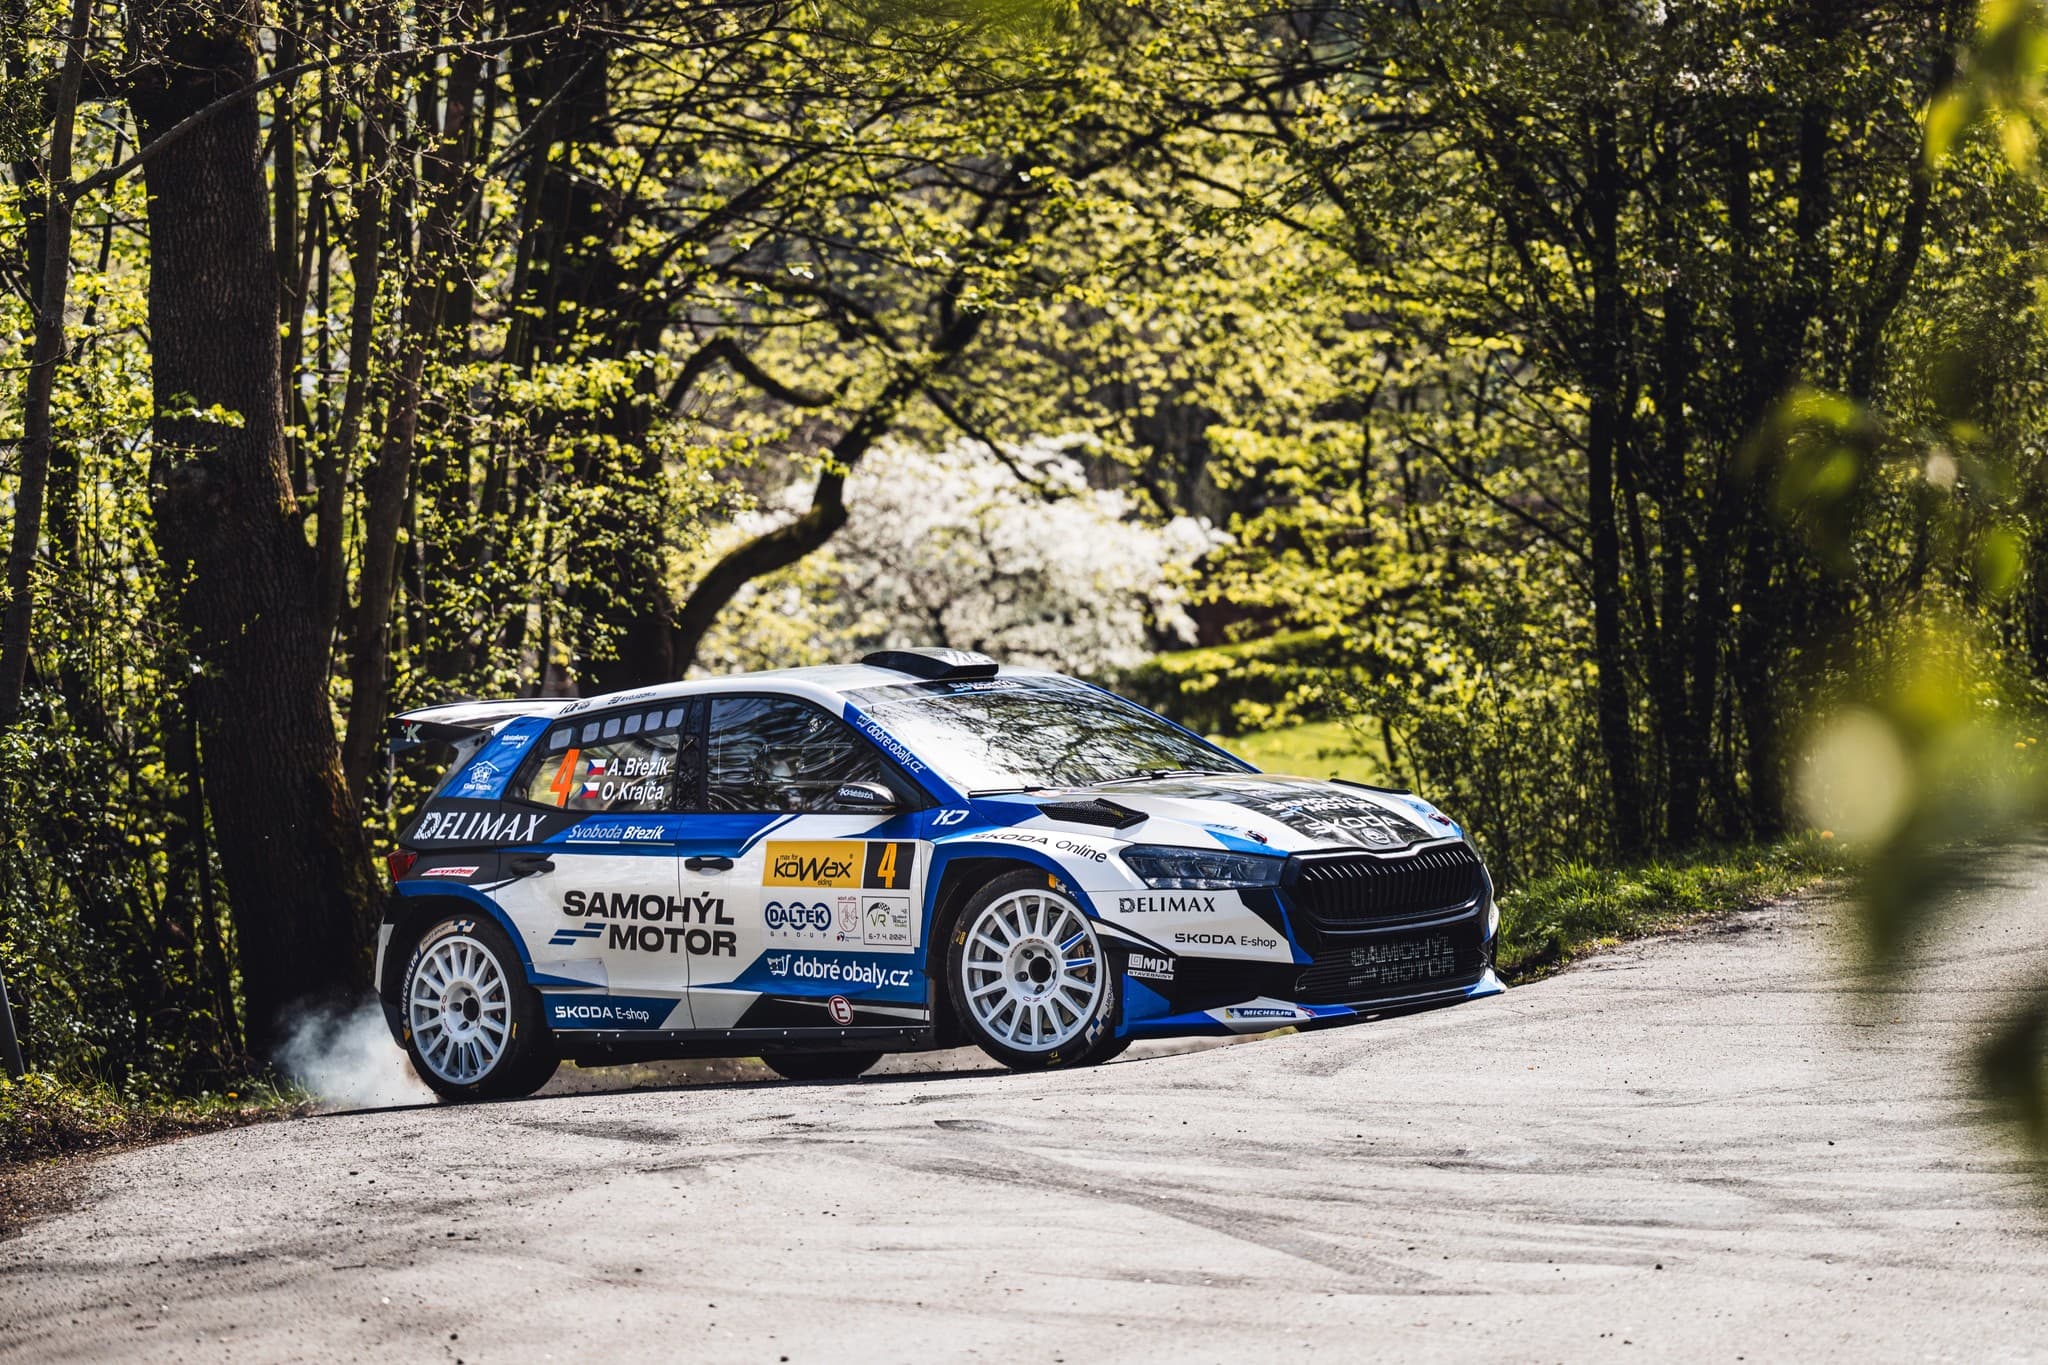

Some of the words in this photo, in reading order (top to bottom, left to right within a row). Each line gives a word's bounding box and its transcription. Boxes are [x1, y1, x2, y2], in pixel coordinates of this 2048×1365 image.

[551, 748, 580, 808] 4
[607, 758, 621, 776] A.
[624, 757, 670, 776] Březík
[602, 783, 616, 800] O.
[618, 781, 665, 805] Krajča
[414, 812, 547, 841] DELIMAX
[568, 824, 622, 839] Svoboda
[623, 825, 665, 840] Březík
[1055, 840, 1107, 863] Online
[877, 843, 897, 888] 4
[562, 890, 734, 925] SAMOHÝL
[769, 909, 826, 924] DALTEK
[1119, 897, 1216, 913] DELIMAX
[608, 924, 737, 957] MOTOR
[1240, 936, 1277, 949] E-shop
[401, 951, 420, 1015] MICHELIN
[793, 956, 840, 980] dobré
[843, 960, 910, 989] obaly.cz
[616, 1007, 649, 1023] E-shop
[833, 1000, 849, 1020] E
[1243, 1009, 1292, 1017] MICHELIN
